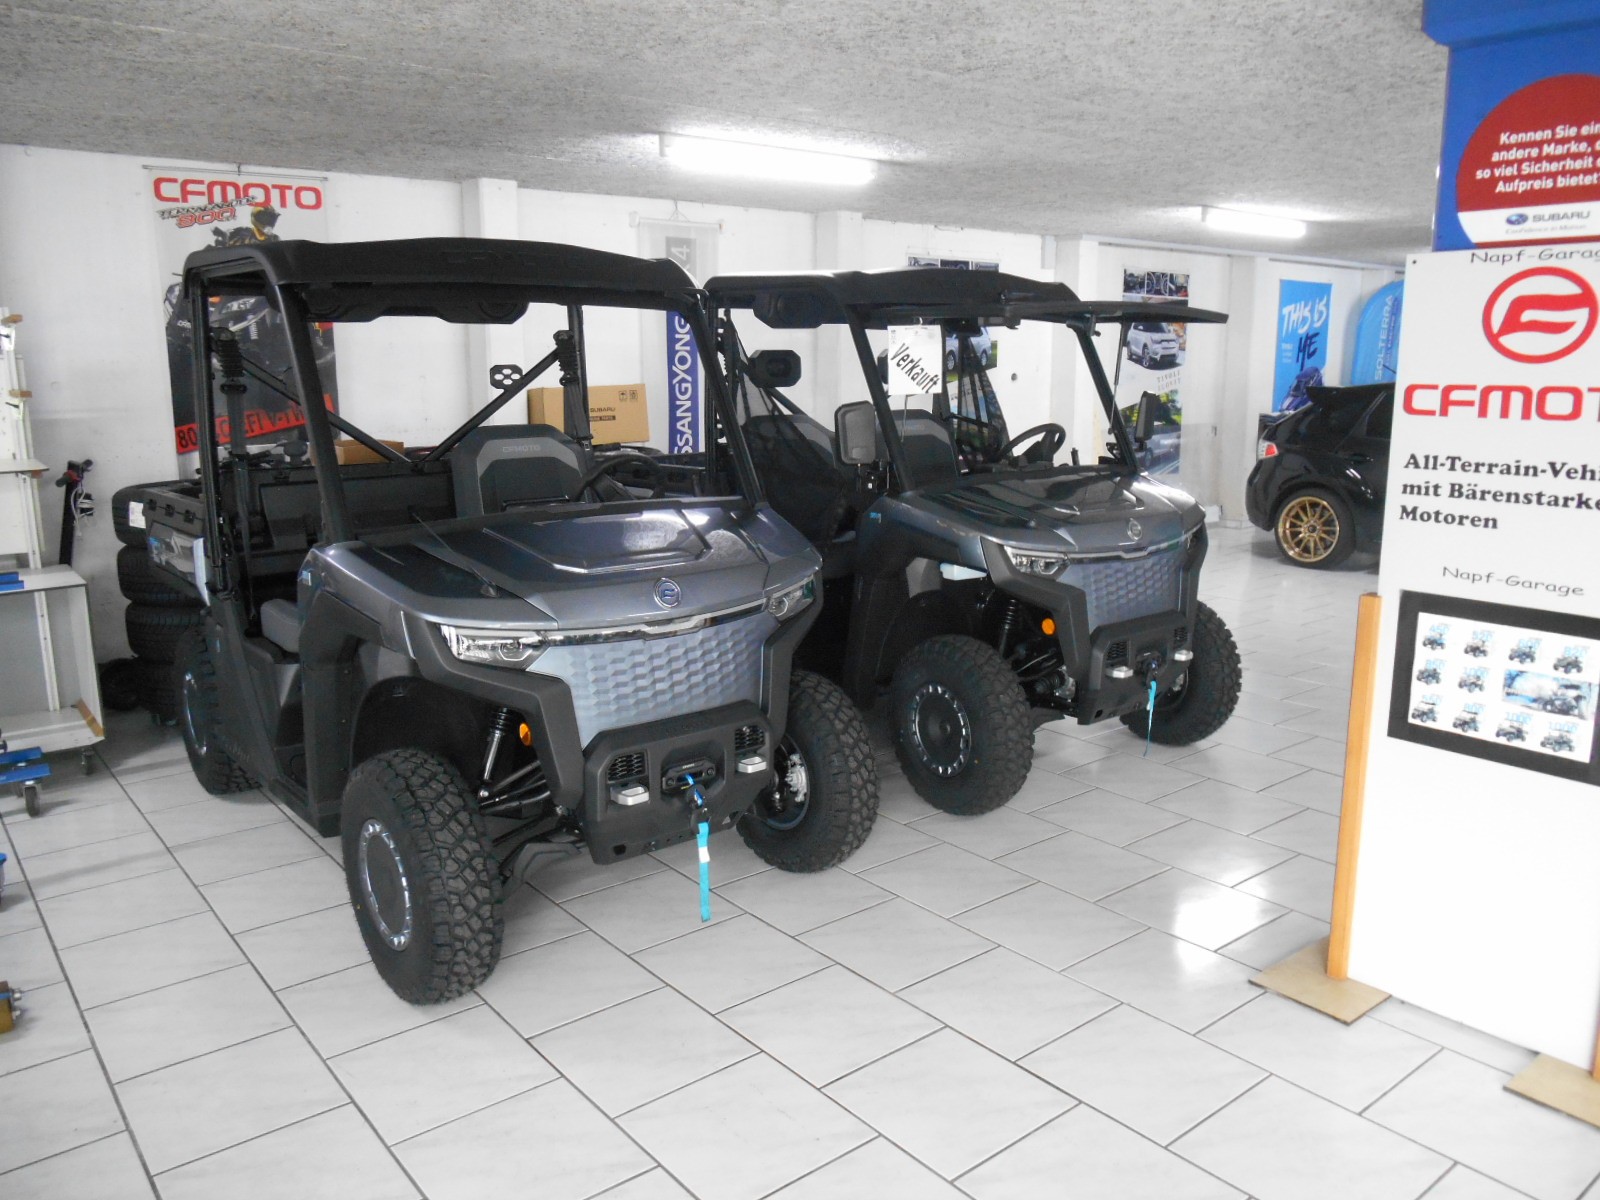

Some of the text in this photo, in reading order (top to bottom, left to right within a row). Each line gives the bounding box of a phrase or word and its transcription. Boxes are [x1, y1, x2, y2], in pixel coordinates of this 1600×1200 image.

[1500, 130, 1551, 145] Kennen
[1555, 124, 1577, 139] Sie
[1491, 147, 1539, 162] andere
[1543, 140, 1592, 156] Marke,
[1475, 168, 1491, 180] so
[1494, 162, 1518, 177] viel
[1521, 155, 1593, 175] Sicherheit
[153, 176, 322, 210] CFMOTO
[1495, 171, 1600, 193] Aufpreis bietet
[1532, 211, 1591, 222] SUBARU
[1282, 296, 1327, 338] THIS IS
[1375, 295, 1394, 381] SOLTERRA
[890, 342, 940, 394] Verkauft
[1401, 481, 1442, 497] mit
[1399, 504, 1498, 530] Motoren
[1442, 566, 1585, 598] Napf-Garage
